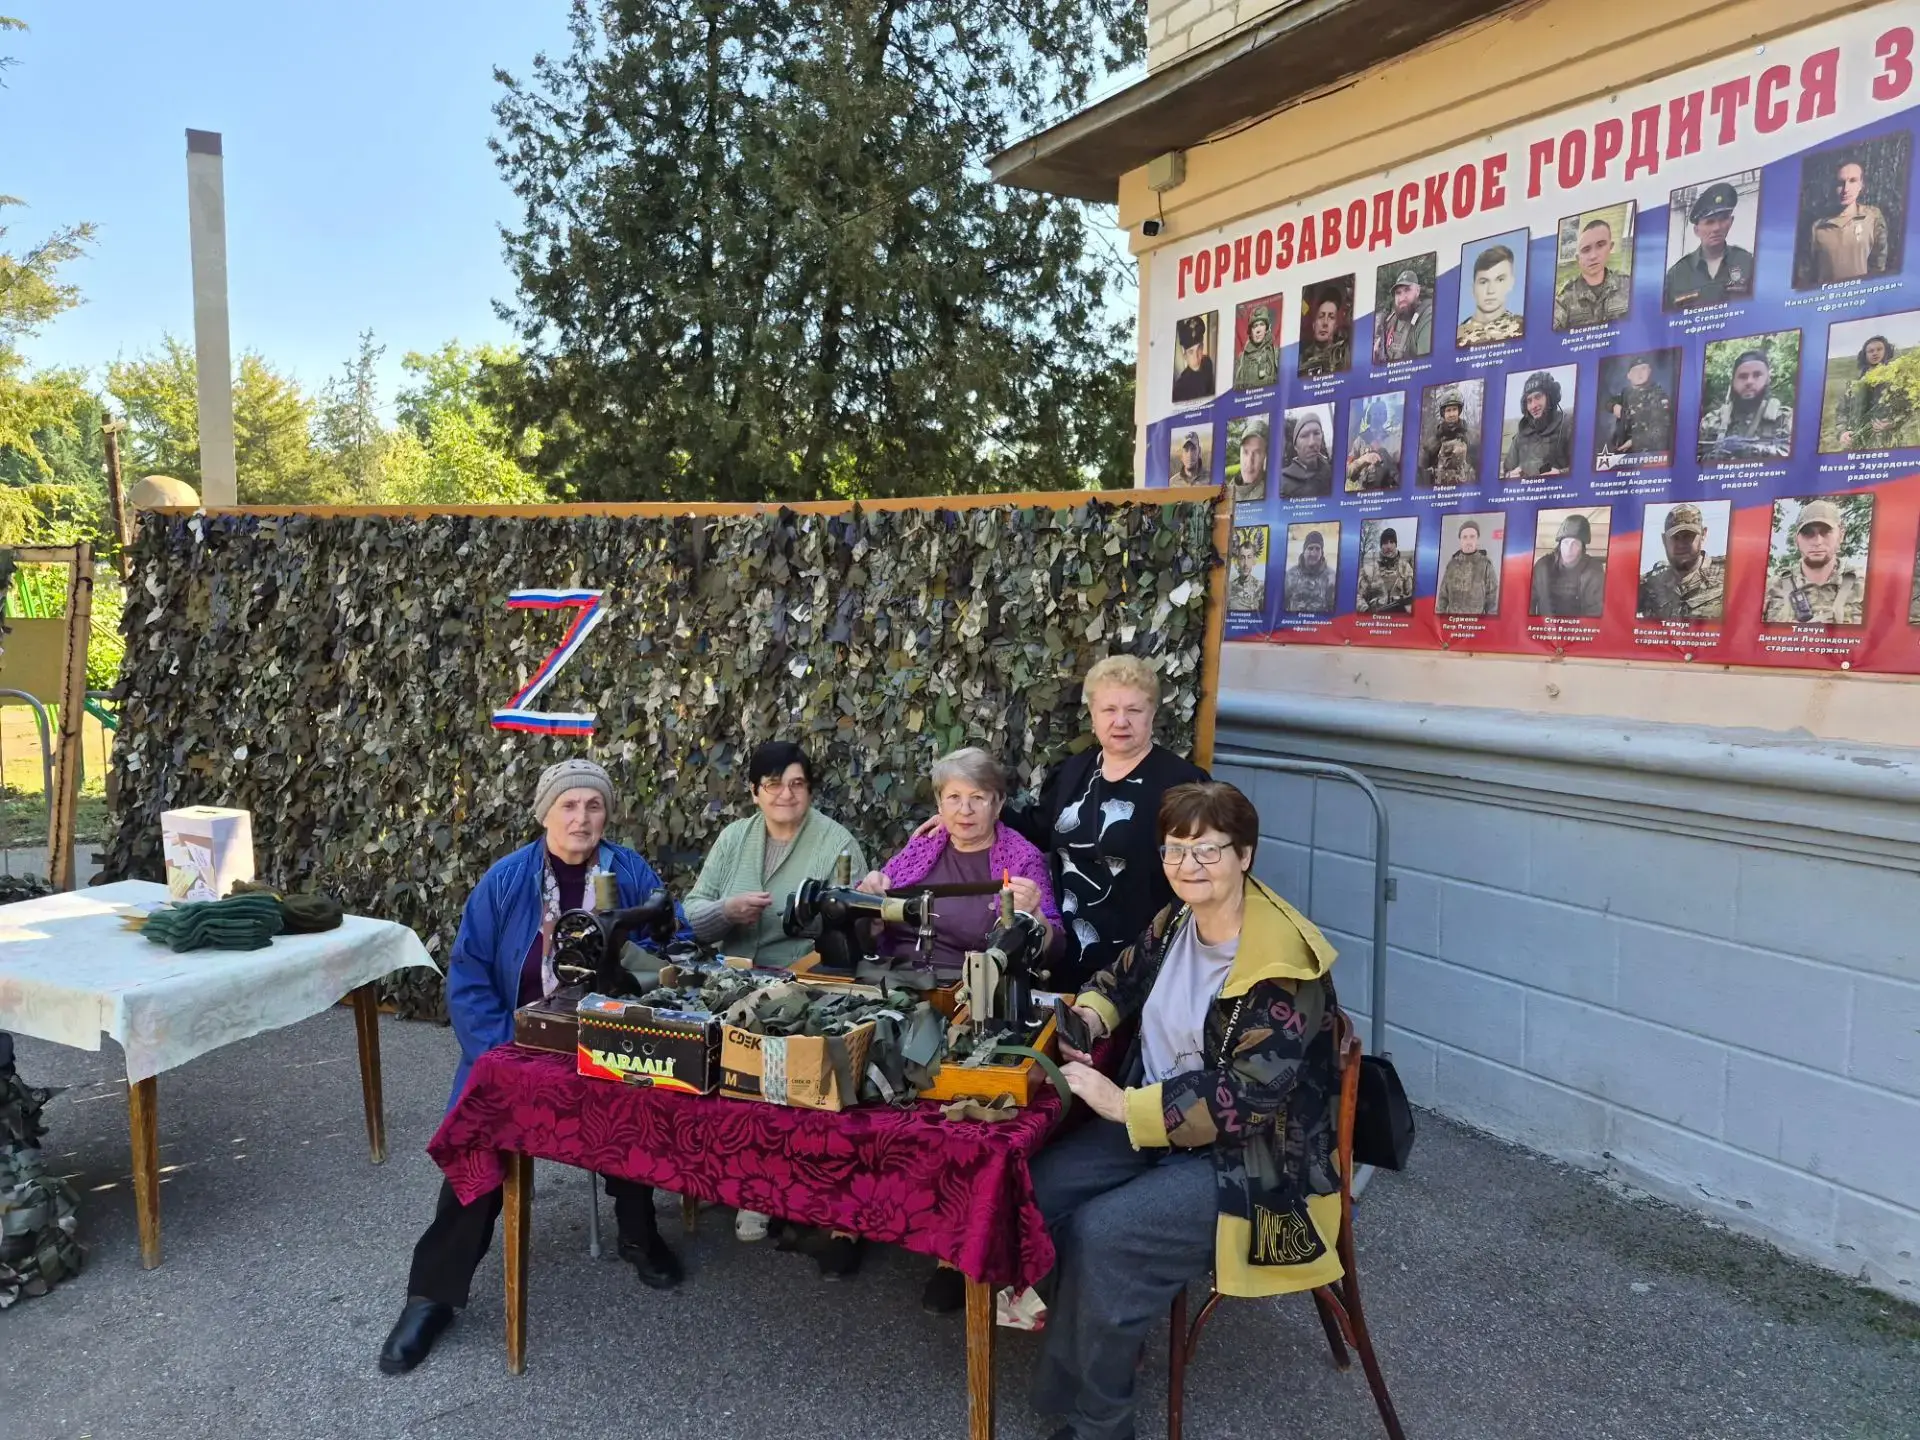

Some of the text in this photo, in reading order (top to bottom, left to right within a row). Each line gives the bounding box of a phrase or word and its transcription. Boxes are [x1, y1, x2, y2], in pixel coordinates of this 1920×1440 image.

[1178, 153, 1508, 300] ГОРНОЗАВОДСКОЕ
[1527, 46, 1841, 199] ГОРДИТСЯ
[1822, 279, 1861, 290] Говоров
[1785, 282, 1904, 307] Николай Владимирович
[1683, 303, 1728, 316] Василисов
[1817, 299, 1866, 312] ефрейтор
[1669, 310, 1745, 328] Игорь Степанович
[1685, 322, 1726, 334] ефрейтор
[1562, 337, 1584, 346] Денис
[1848, 452, 1890, 461] Матвеев
[1819, 460, 1920, 472] Матвей Эдуардович
[1697, 470, 1786, 482] Дмитрий Сергеевич
[1848, 471, 1889, 482] рядовой
[1628, 478, 1672, 486] Андреевич
[1721, 481, 1759, 490] рядовой
[1631, 487, 1665, 495] сержант
[1661, 620, 1691, 629] Ткачук
[1633, 628, 1721, 638] Василий Леонидович
[1792, 626, 1825, 635] Ткачук
[1670, 640, 1718, 648] прапорщик
[1758, 634, 1861, 645] Дмитрий Леонидович
[1765, 645, 1850, 655] старший сержант
[491, 588, 608, 736] Z
[729, 1030, 761, 1051] CDEK
[725, 1072, 737, 1087] M
